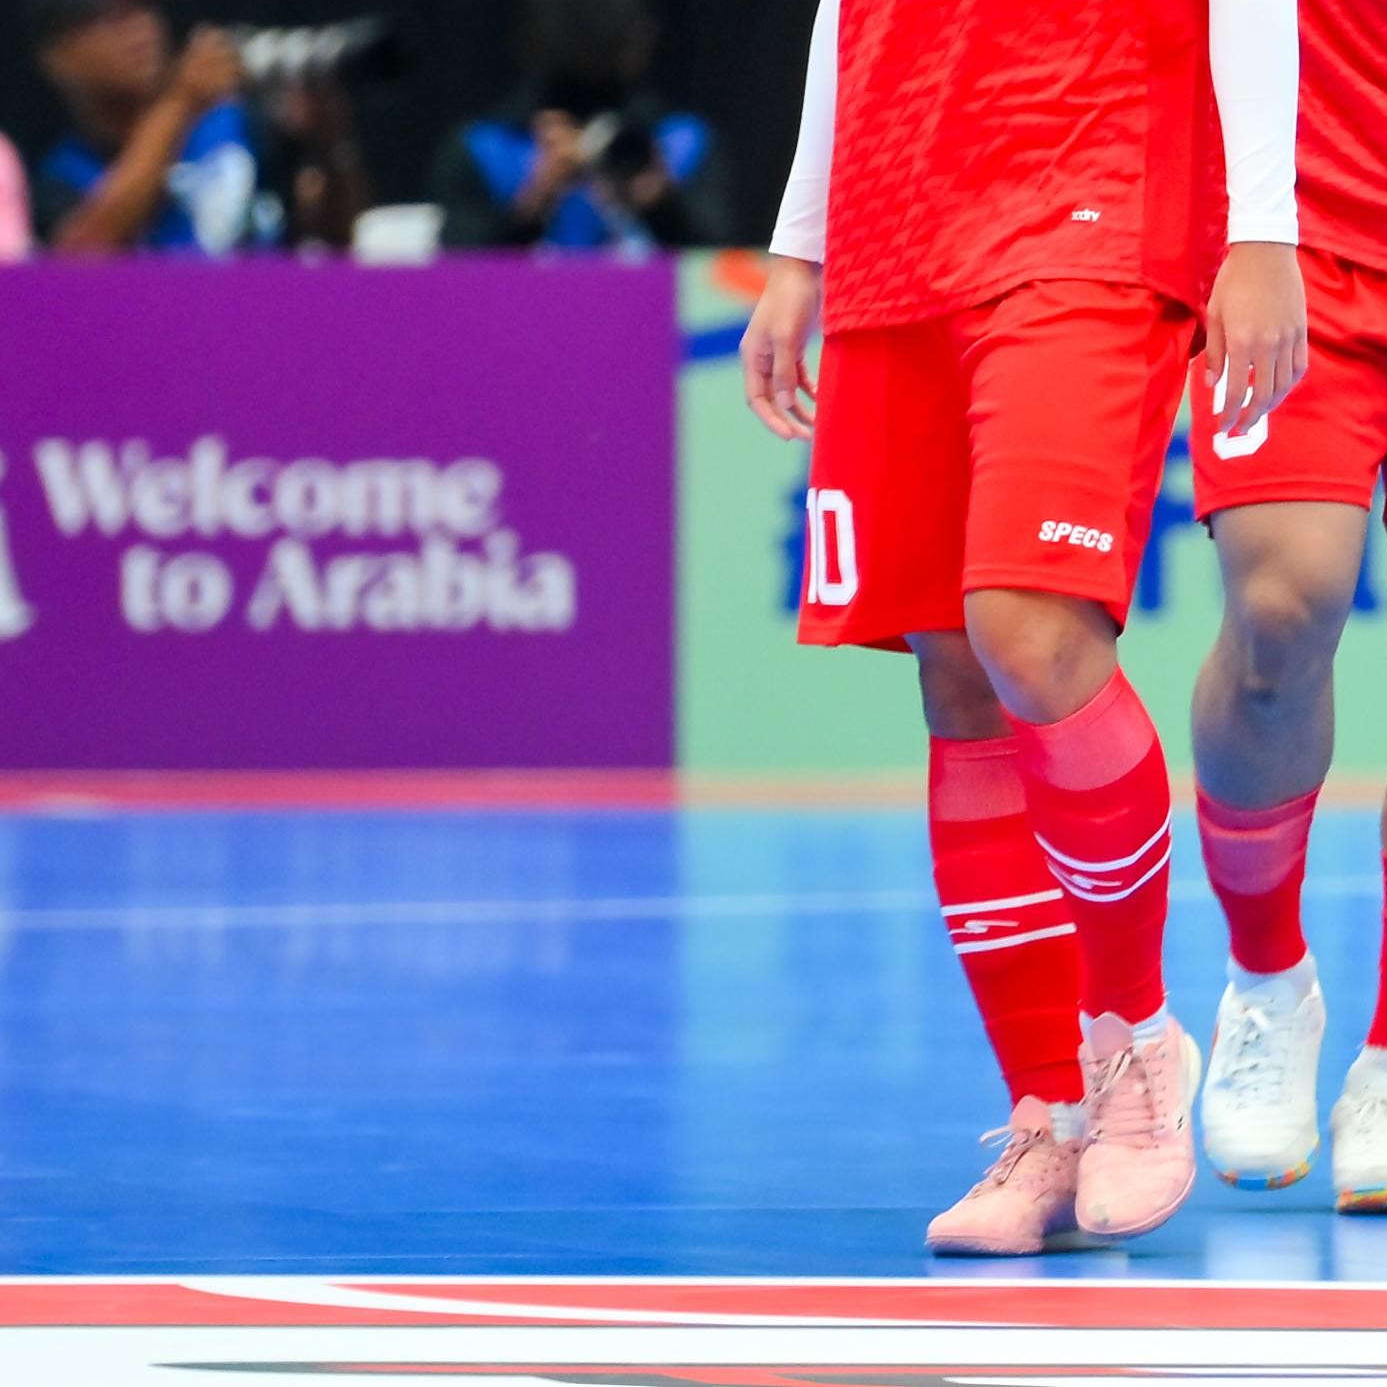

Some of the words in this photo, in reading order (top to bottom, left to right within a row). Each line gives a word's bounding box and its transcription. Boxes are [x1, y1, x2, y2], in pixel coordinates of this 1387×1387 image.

[34, 434, 503, 538] Welcome
[1038, 520, 1114, 553] SPECS
[120, 543, 235, 633] to
[245, 526, 577, 633] Arabia
[806, 487, 860, 606] 10
